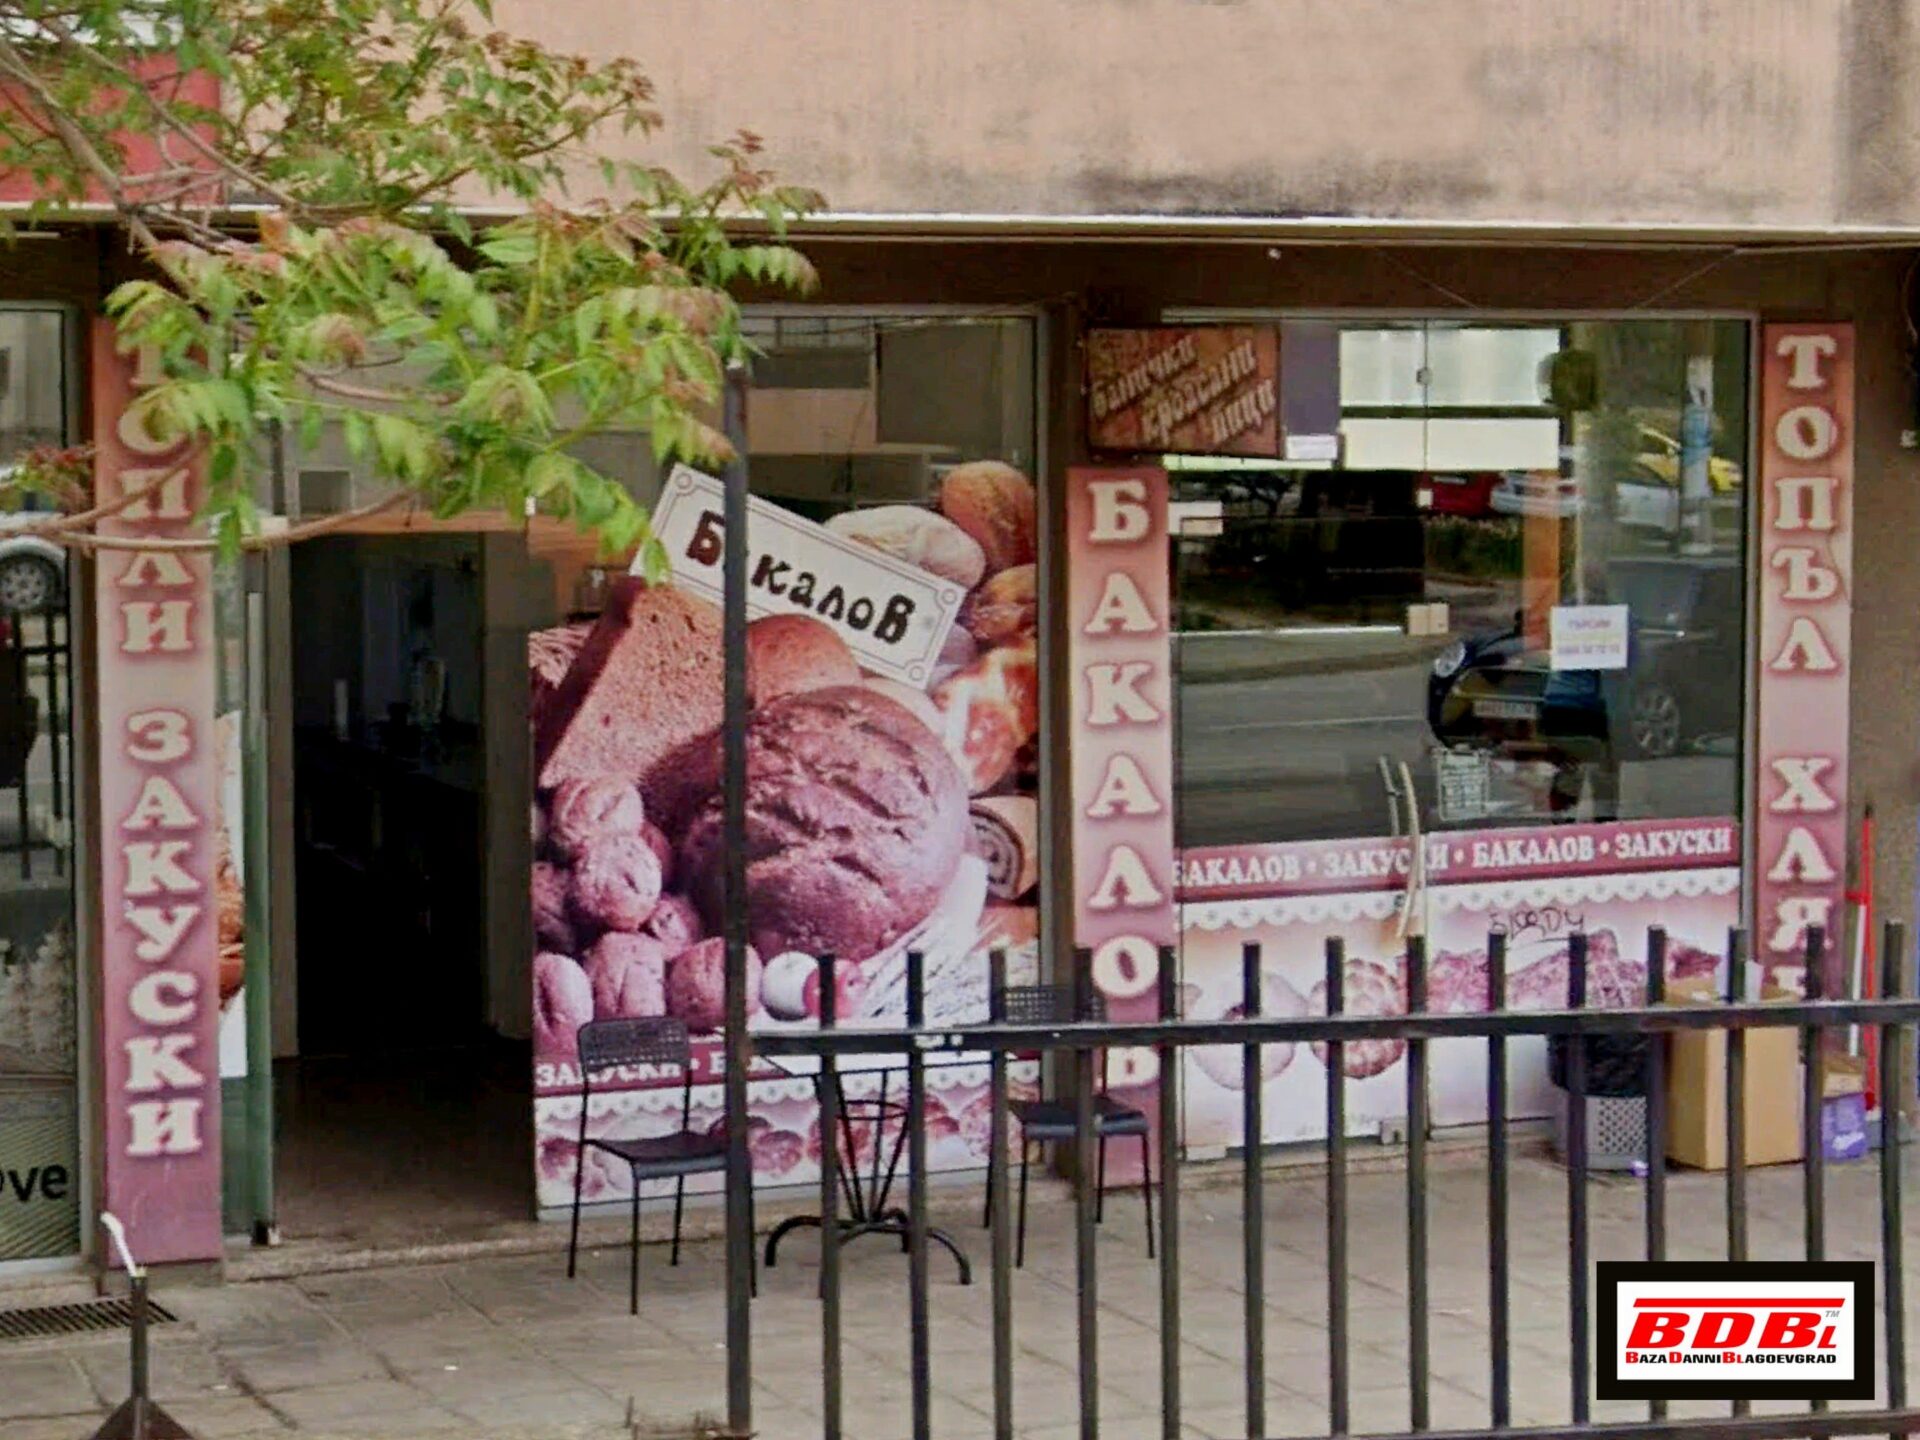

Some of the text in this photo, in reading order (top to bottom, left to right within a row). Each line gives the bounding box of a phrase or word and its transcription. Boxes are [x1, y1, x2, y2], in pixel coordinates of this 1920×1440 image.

[1770, 334, 1839, 670] ТОПЪЛ
[685, 510, 917, 645] Бкалов
[1472, 835, 1595, 869] БАКАЛОВ
[1614, 826, 1732, 858] ЗАКУСКИ
[121, 711, 203, 1156] ЗАКУСКИ
[0, 1164, 67, 1201] ve
